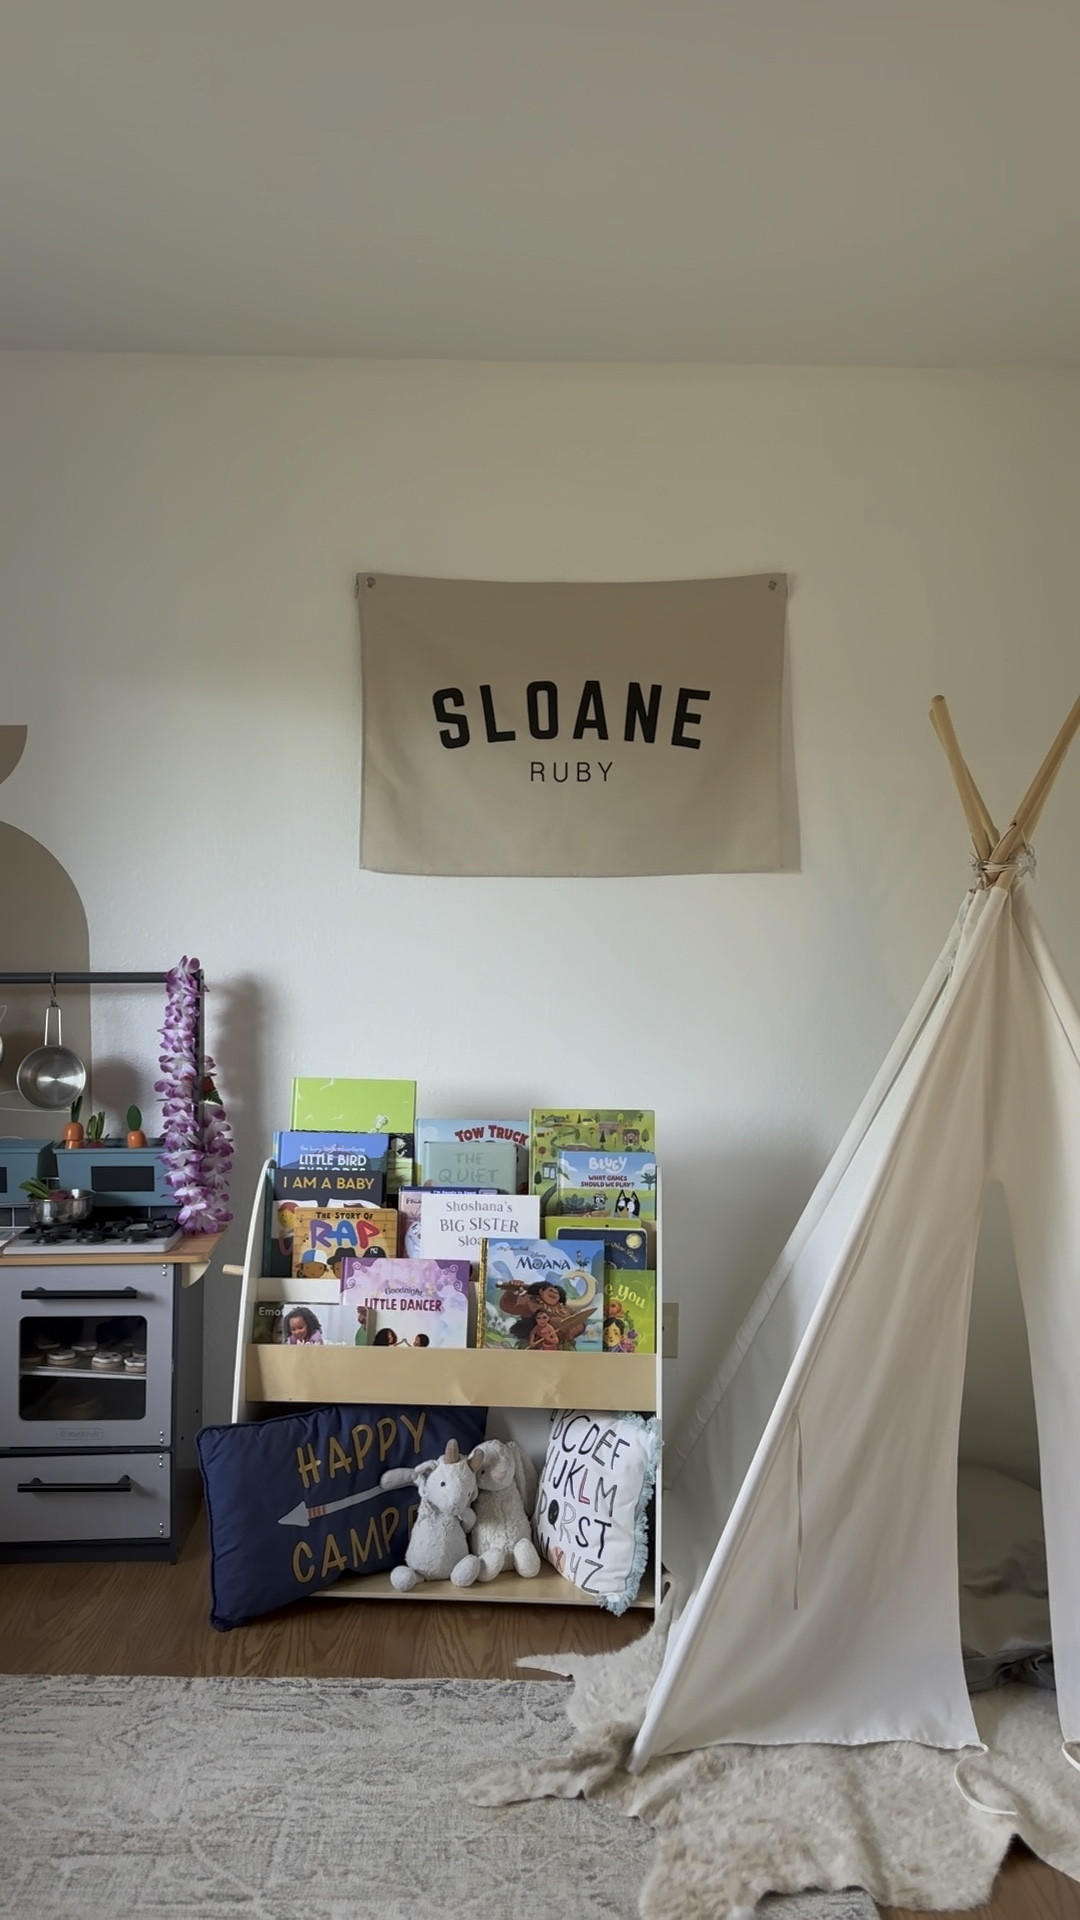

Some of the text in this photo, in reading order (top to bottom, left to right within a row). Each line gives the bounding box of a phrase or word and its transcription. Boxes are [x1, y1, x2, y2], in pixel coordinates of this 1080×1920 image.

[432, 681, 711, 750] SLOANE
[530, 761, 614, 782] RUBY
[454, 1124, 530, 1146] TOW TRUCK
[299, 1153, 367, 1167] LITTLE BIRD
[454, 1151, 484, 1166] THE
[282, 1176, 376, 1190] I AM A BABY
[438, 1168, 500, 1184] QUIET
[606, 1174, 628, 1182] GAMES
[615, 1181, 636, 1189] PLAY?
[446, 1200, 513, 1214] Shoshana's
[316, 1211, 375, 1220] THE STORY OF
[440, 1217, 519, 1233] BIG SISTER
[309, 1219, 381, 1249] RAP
[457, 1234, 482, 1247] Sloa
[515, 1256, 571, 1271] MOANA
[384, 1287, 424, 1298] Goodnight
[258, 1306, 282, 1317] Emo
[364, 1298, 443, 1313] LITTLE DANCER
[296, 1412, 426, 1489] HAPPY
